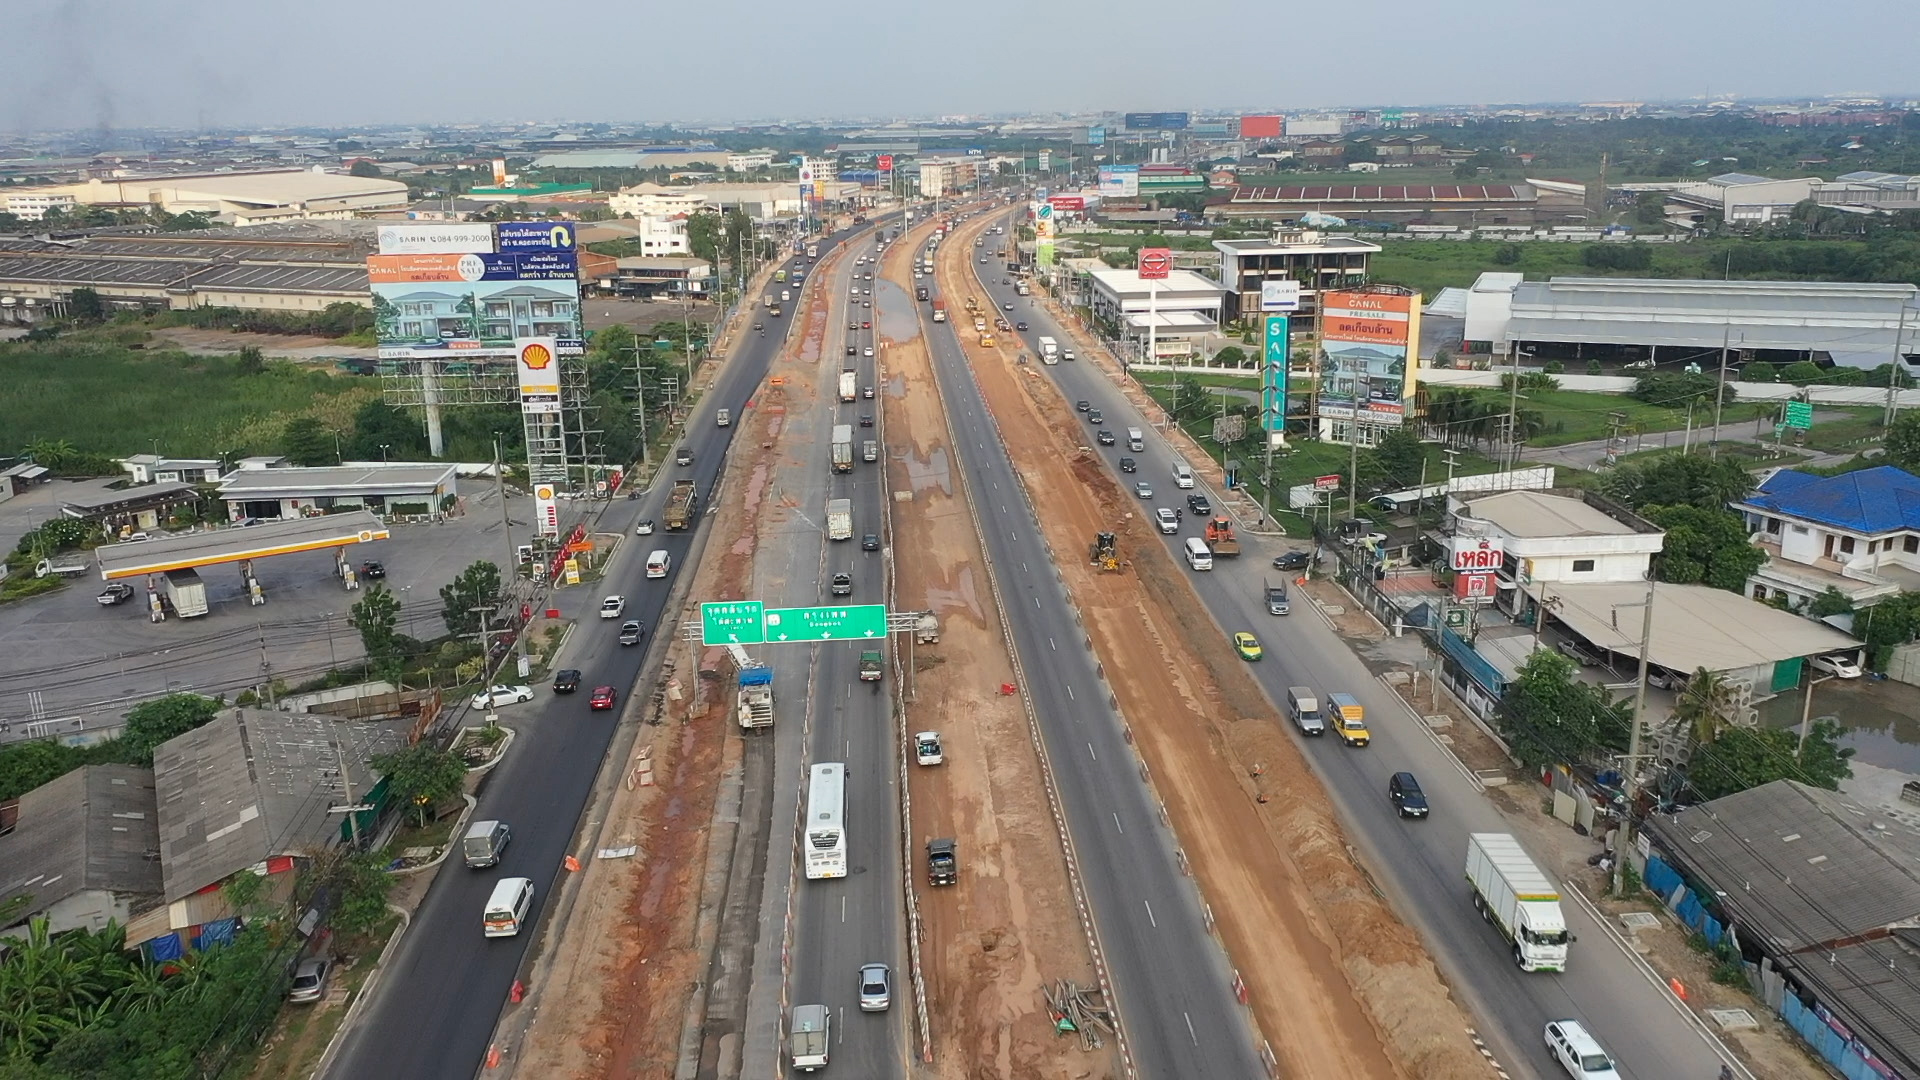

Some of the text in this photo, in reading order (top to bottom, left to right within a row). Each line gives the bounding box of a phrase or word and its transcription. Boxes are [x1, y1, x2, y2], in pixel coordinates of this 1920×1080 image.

[369, 267, 397, 275] CANAL
[1348, 299, 1382, 309] CANAL
[1339, 321, 1393, 335] ลดเกือบล้าน
[544, 404, 554, 412] 24
[1455, 542, 1502, 568] เหล็ก
[707, 603, 758, 618] จุดกลับรถ
[712, 616, 754, 626] ใต้สะพาน
